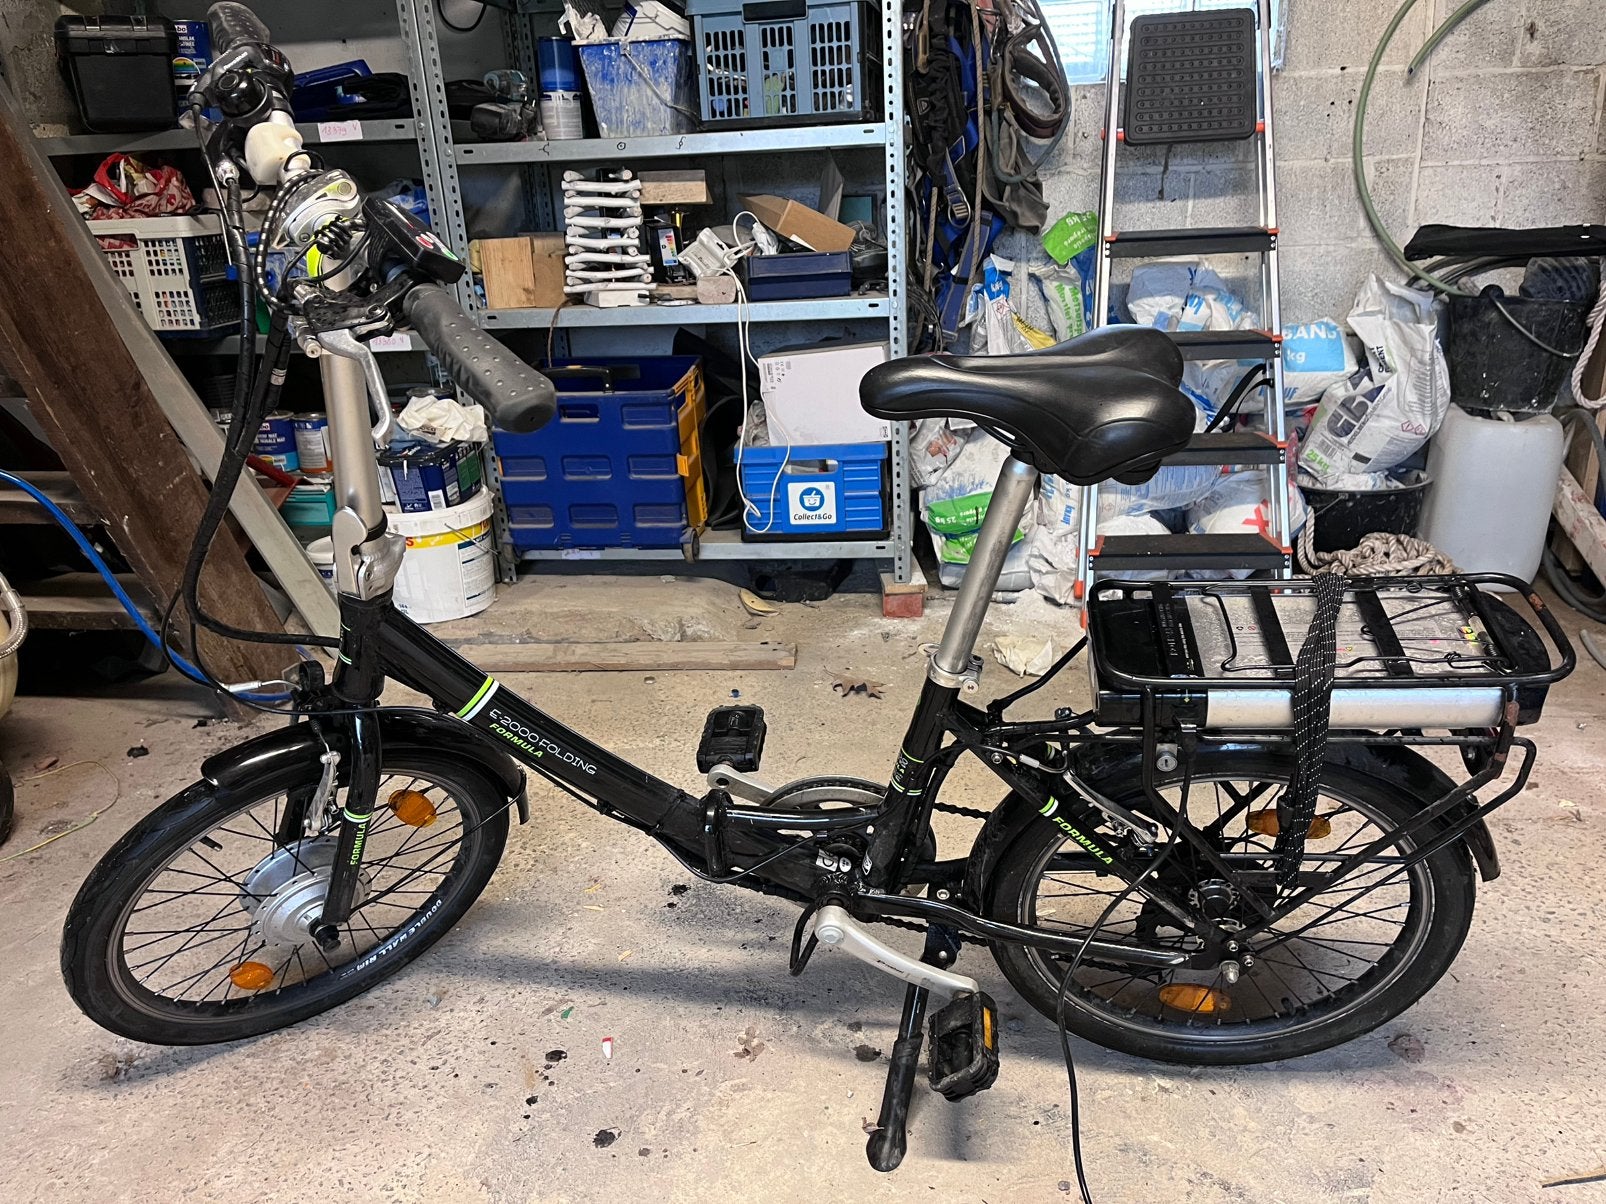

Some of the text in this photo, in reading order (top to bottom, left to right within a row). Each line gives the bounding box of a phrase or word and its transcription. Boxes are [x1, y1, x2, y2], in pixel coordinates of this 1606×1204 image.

[1286, 349, 1306, 364] kg
[1305, 449, 1318, 463] 25
[793, 512, 833, 521] Collect&Go
[934, 516, 957, 525] 25 kg
[488, 722, 545, 759] FORMULA
[537, 737, 598, 776] FOLDING
[349, 822, 368, 866] FORMULA
[1051, 815, 1115, 865] FORMULA
[408, 899, 443, 936] DOUBLE
[378, 932, 408, 957] WALL
